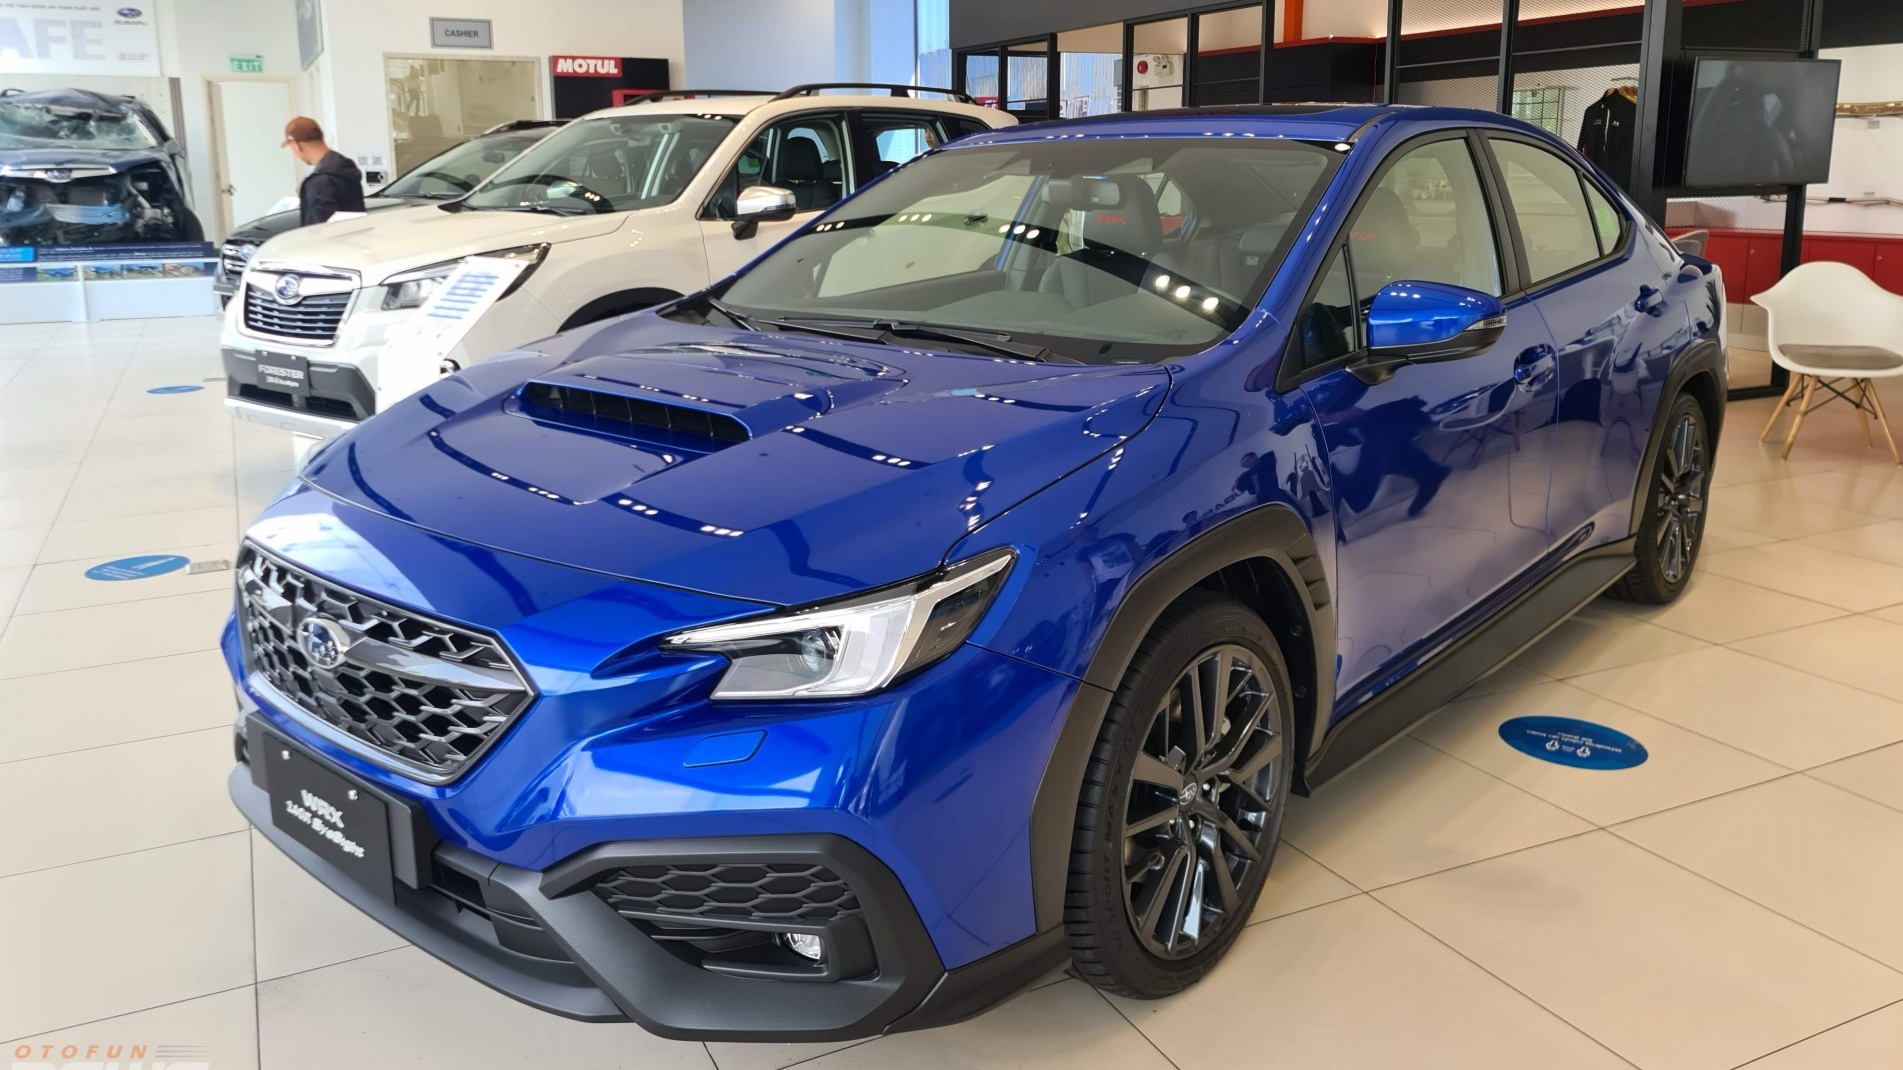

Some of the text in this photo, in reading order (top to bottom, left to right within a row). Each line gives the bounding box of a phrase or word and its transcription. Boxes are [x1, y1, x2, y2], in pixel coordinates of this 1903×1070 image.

[445, 29, 479, 39] CASHIER
[232, 61, 261, 72] EXIT
[556, 58, 618, 74] MOTUL
[258, 364, 304, 379] FORESTER
[301, 789, 345, 828] WRX
[1103, 853, 1117, 924] SPORT
